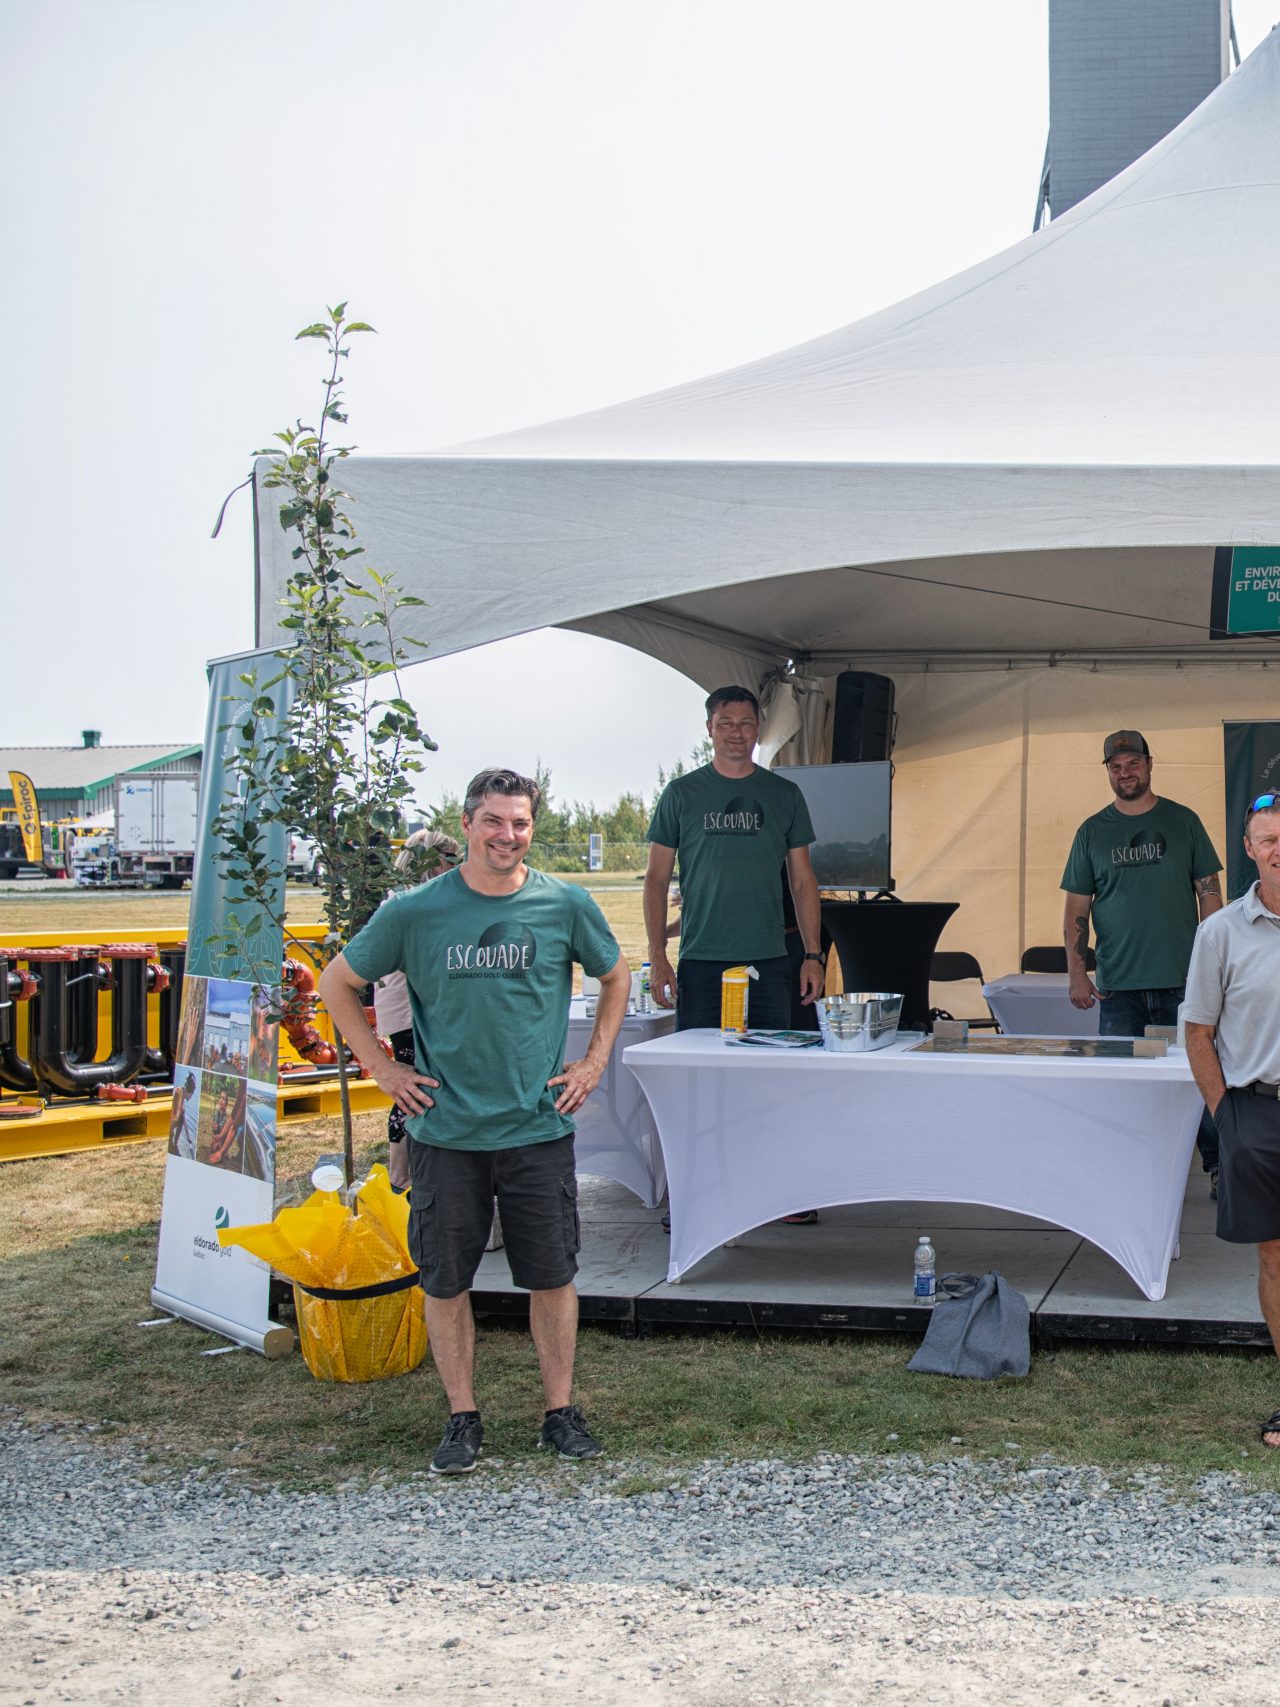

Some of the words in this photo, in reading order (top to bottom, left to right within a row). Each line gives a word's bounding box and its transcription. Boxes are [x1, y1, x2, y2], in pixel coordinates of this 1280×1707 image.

[1235, 580, 1250, 592] ET
[18, 780, 35, 820] Epiroc
[704, 811, 761, 830] ESCOUADE
[1111, 843, 1164, 864] ESCOUADE
[447, 943, 530, 970] ESCOUADE
[448, 972, 483, 980] ELDORADO
[193, 1235, 220, 1253] eldorado
